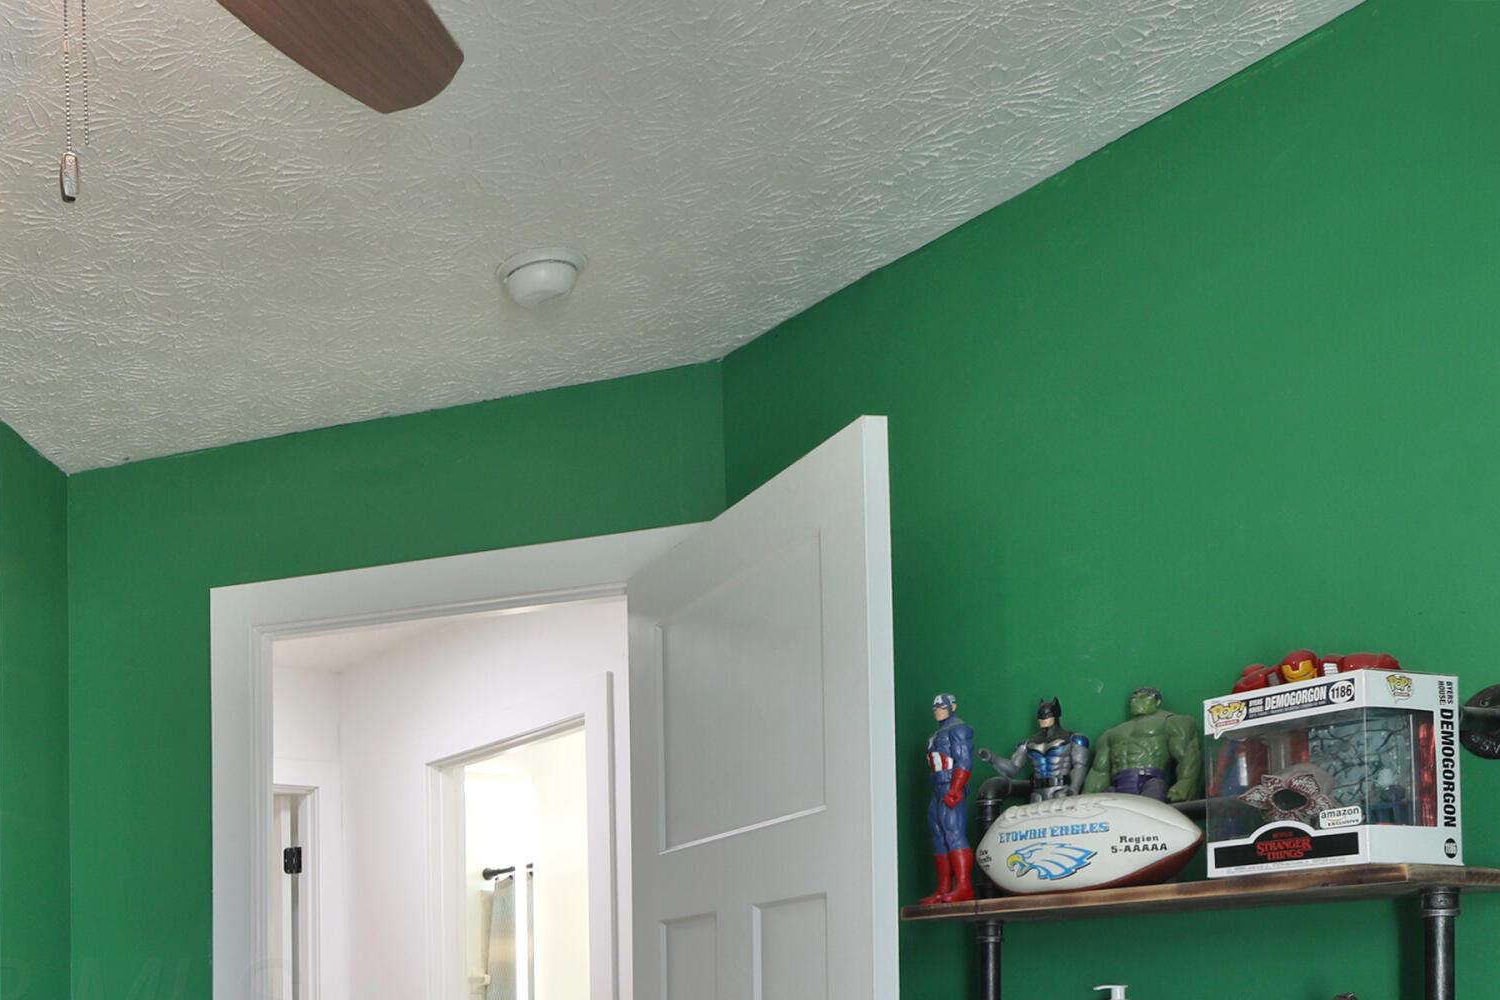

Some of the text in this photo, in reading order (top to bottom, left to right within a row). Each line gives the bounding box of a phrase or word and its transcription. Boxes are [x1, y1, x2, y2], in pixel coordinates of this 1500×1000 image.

[1264, 685, 1328, 710] DEMOGORGON
[1331, 684, 1352, 699] 1186
[1208, 701, 1246, 722] POP!
[1440, 708, 1456, 827] DEMOGORGON
[1321, 807, 1359, 819] amazon
[999, 821, 1110, 844] ETOWAH EAGLES
[1119, 835, 1159, 845] Region
[1111, 843, 1168, 854] 5-AAAAA
[1255, 836, 1313, 856] STRANGER
[1266, 849, 1304, 861] THINGS
